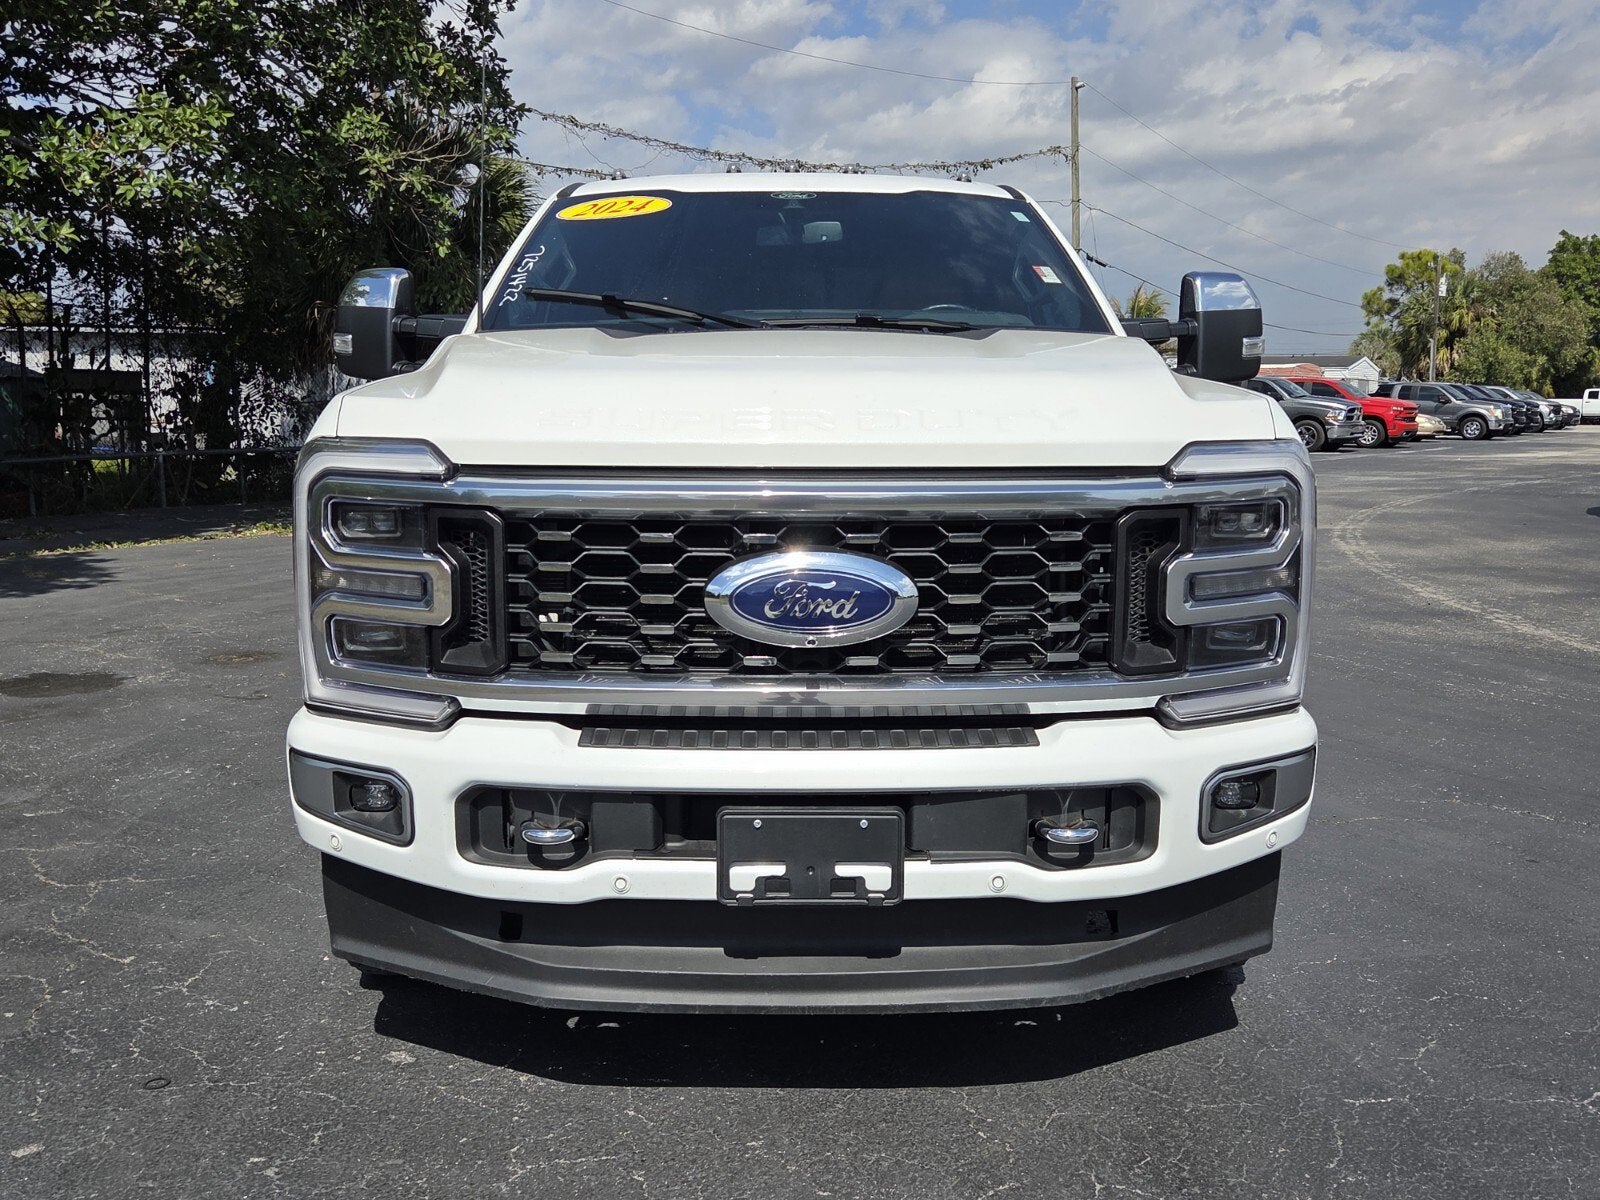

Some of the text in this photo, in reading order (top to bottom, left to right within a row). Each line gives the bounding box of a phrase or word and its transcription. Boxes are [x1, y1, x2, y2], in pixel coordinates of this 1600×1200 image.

[572, 200, 655, 217] 2024
[537, 407, 835, 432] SUPER
[764, 579, 861, 619] Ford
